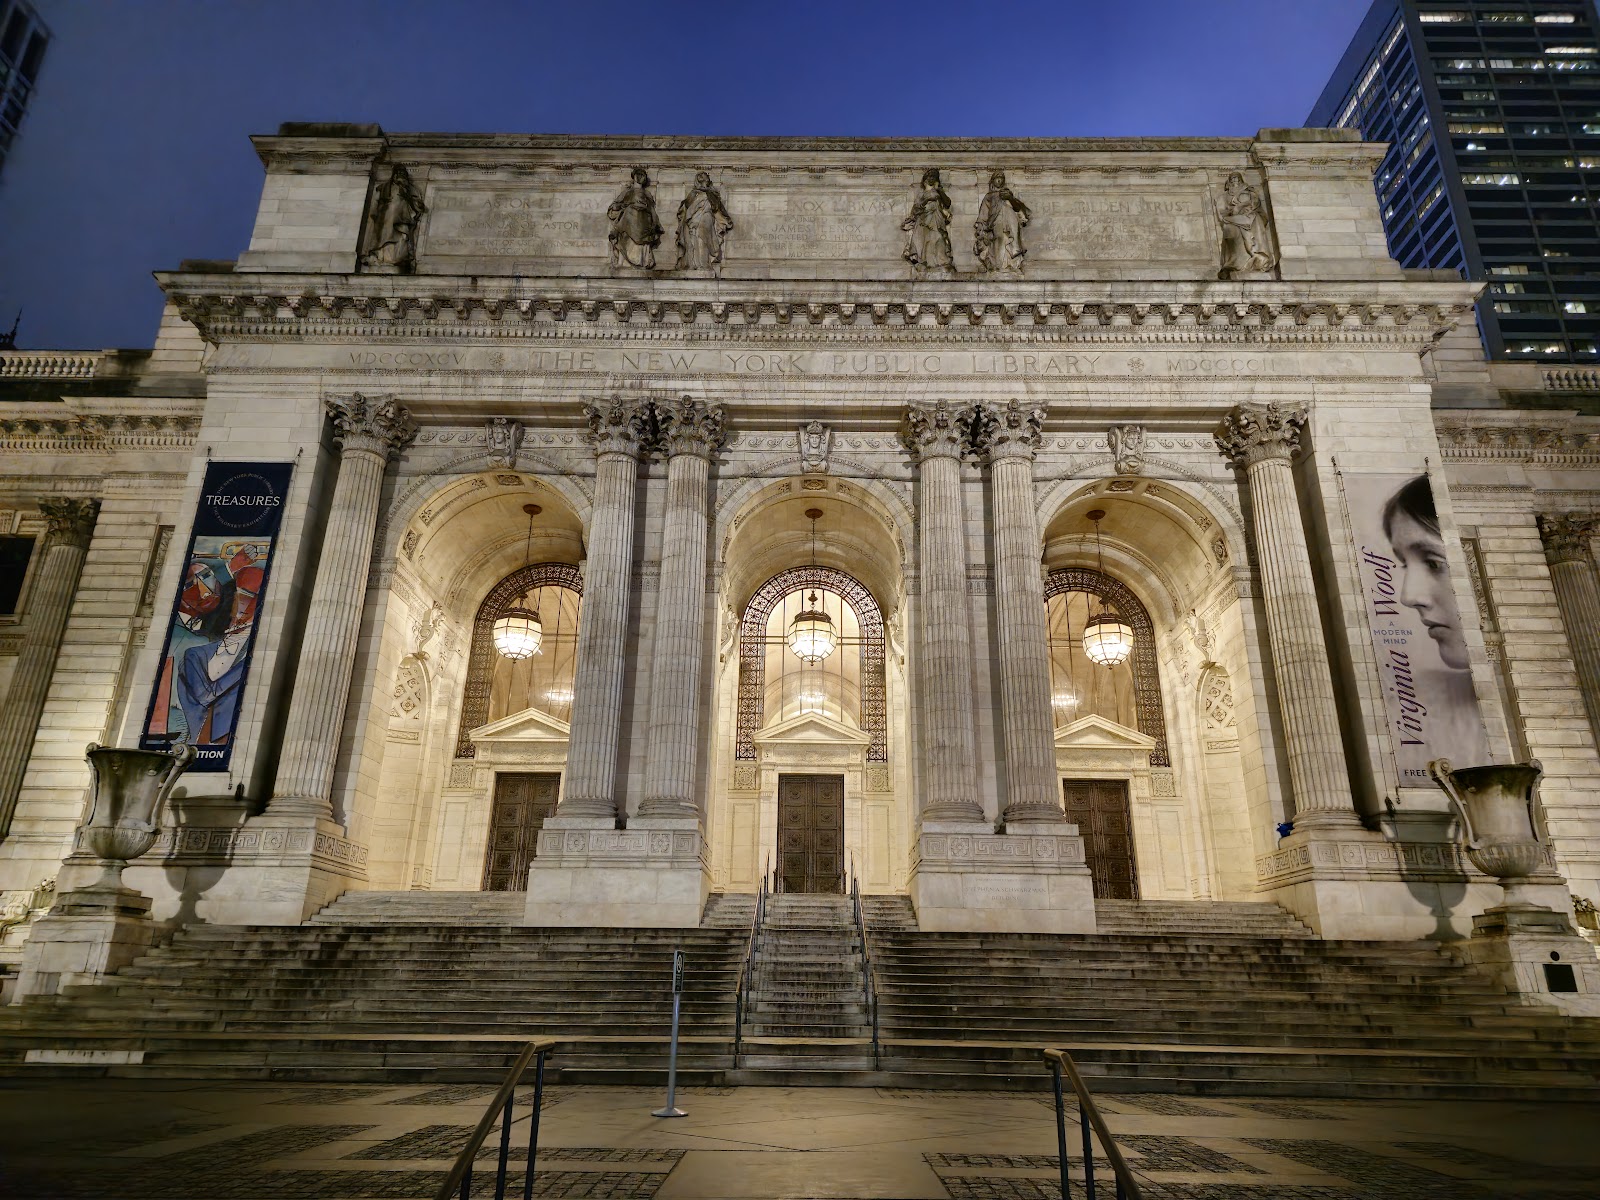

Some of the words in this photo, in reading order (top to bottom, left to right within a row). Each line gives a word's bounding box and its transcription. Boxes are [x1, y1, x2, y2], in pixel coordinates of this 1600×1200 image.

[482, 198, 530, 209] ASTOR
[538, 198, 602, 210] LIBRARY
[833, 201, 895, 212] LIBRARY
[1142, 200, 1192, 213] TRUST
[461, 220, 492, 229] JOHN
[543, 221, 579, 230] ASTOR
[772, 224, 810, 233] JAMES
[821, 224, 862, 233] LENOX
[531, 351, 597, 370] THE
[621, 352, 698, 371] NEW
[725, 354, 806, 373] YORK
[832, 355, 942, 373] PUBLIC
[971, 355, 1100, 374] LIBRARY
[1168, 358, 1275, 372] MDCCCCII
[206, 495, 280, 506] TREASURES
[1361, 545, 1400, 617] Woolf
[1373, 629, 1413, 637] MODERN
[1385, 650, 1427, 746] Virginia
[1404, 769, 1427, 778] FREE
